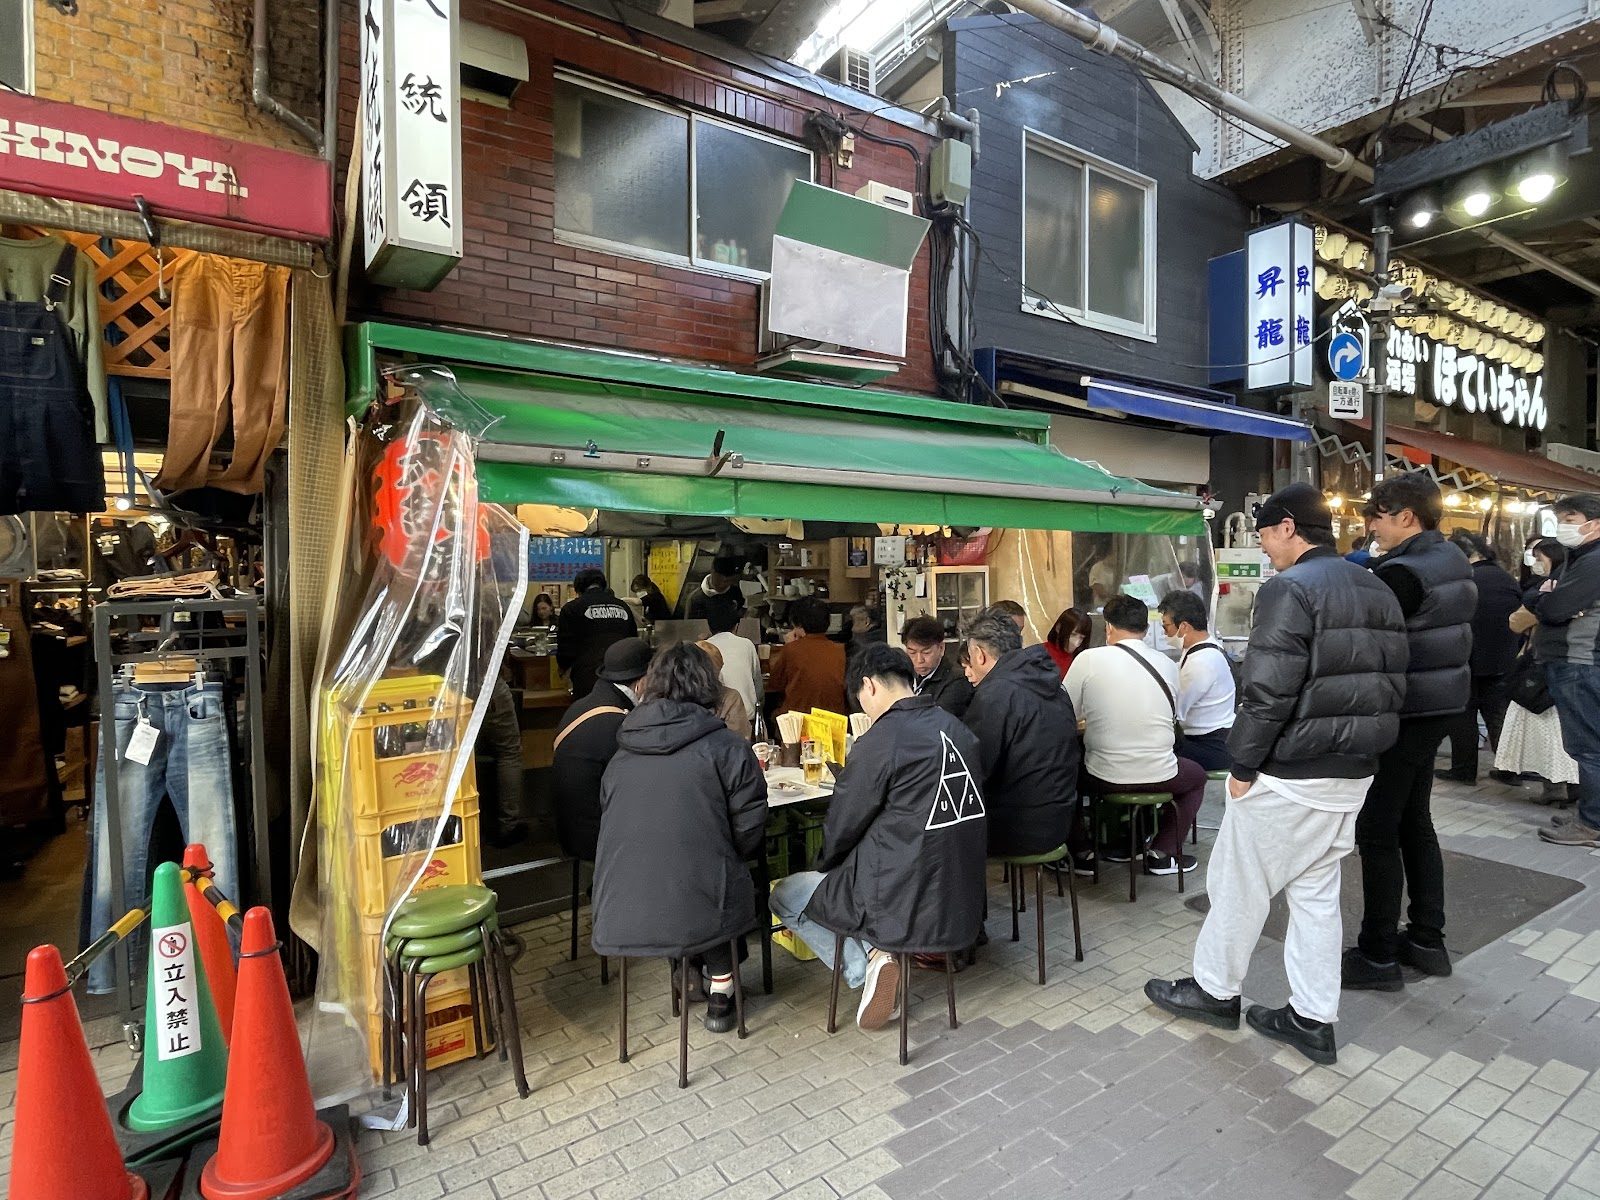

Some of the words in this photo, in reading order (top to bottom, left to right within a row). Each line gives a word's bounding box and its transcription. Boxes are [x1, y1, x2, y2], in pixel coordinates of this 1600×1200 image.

[1254, 265, 1285, 350] 昇龍
[1294, 264, 1311, 346] 昇龍
[1332, 397, 1360, 407] 一方通行
[1433, 343, 1547, 431] ほていちゃん
[164, 963, 190, 1053] 立入禁止
